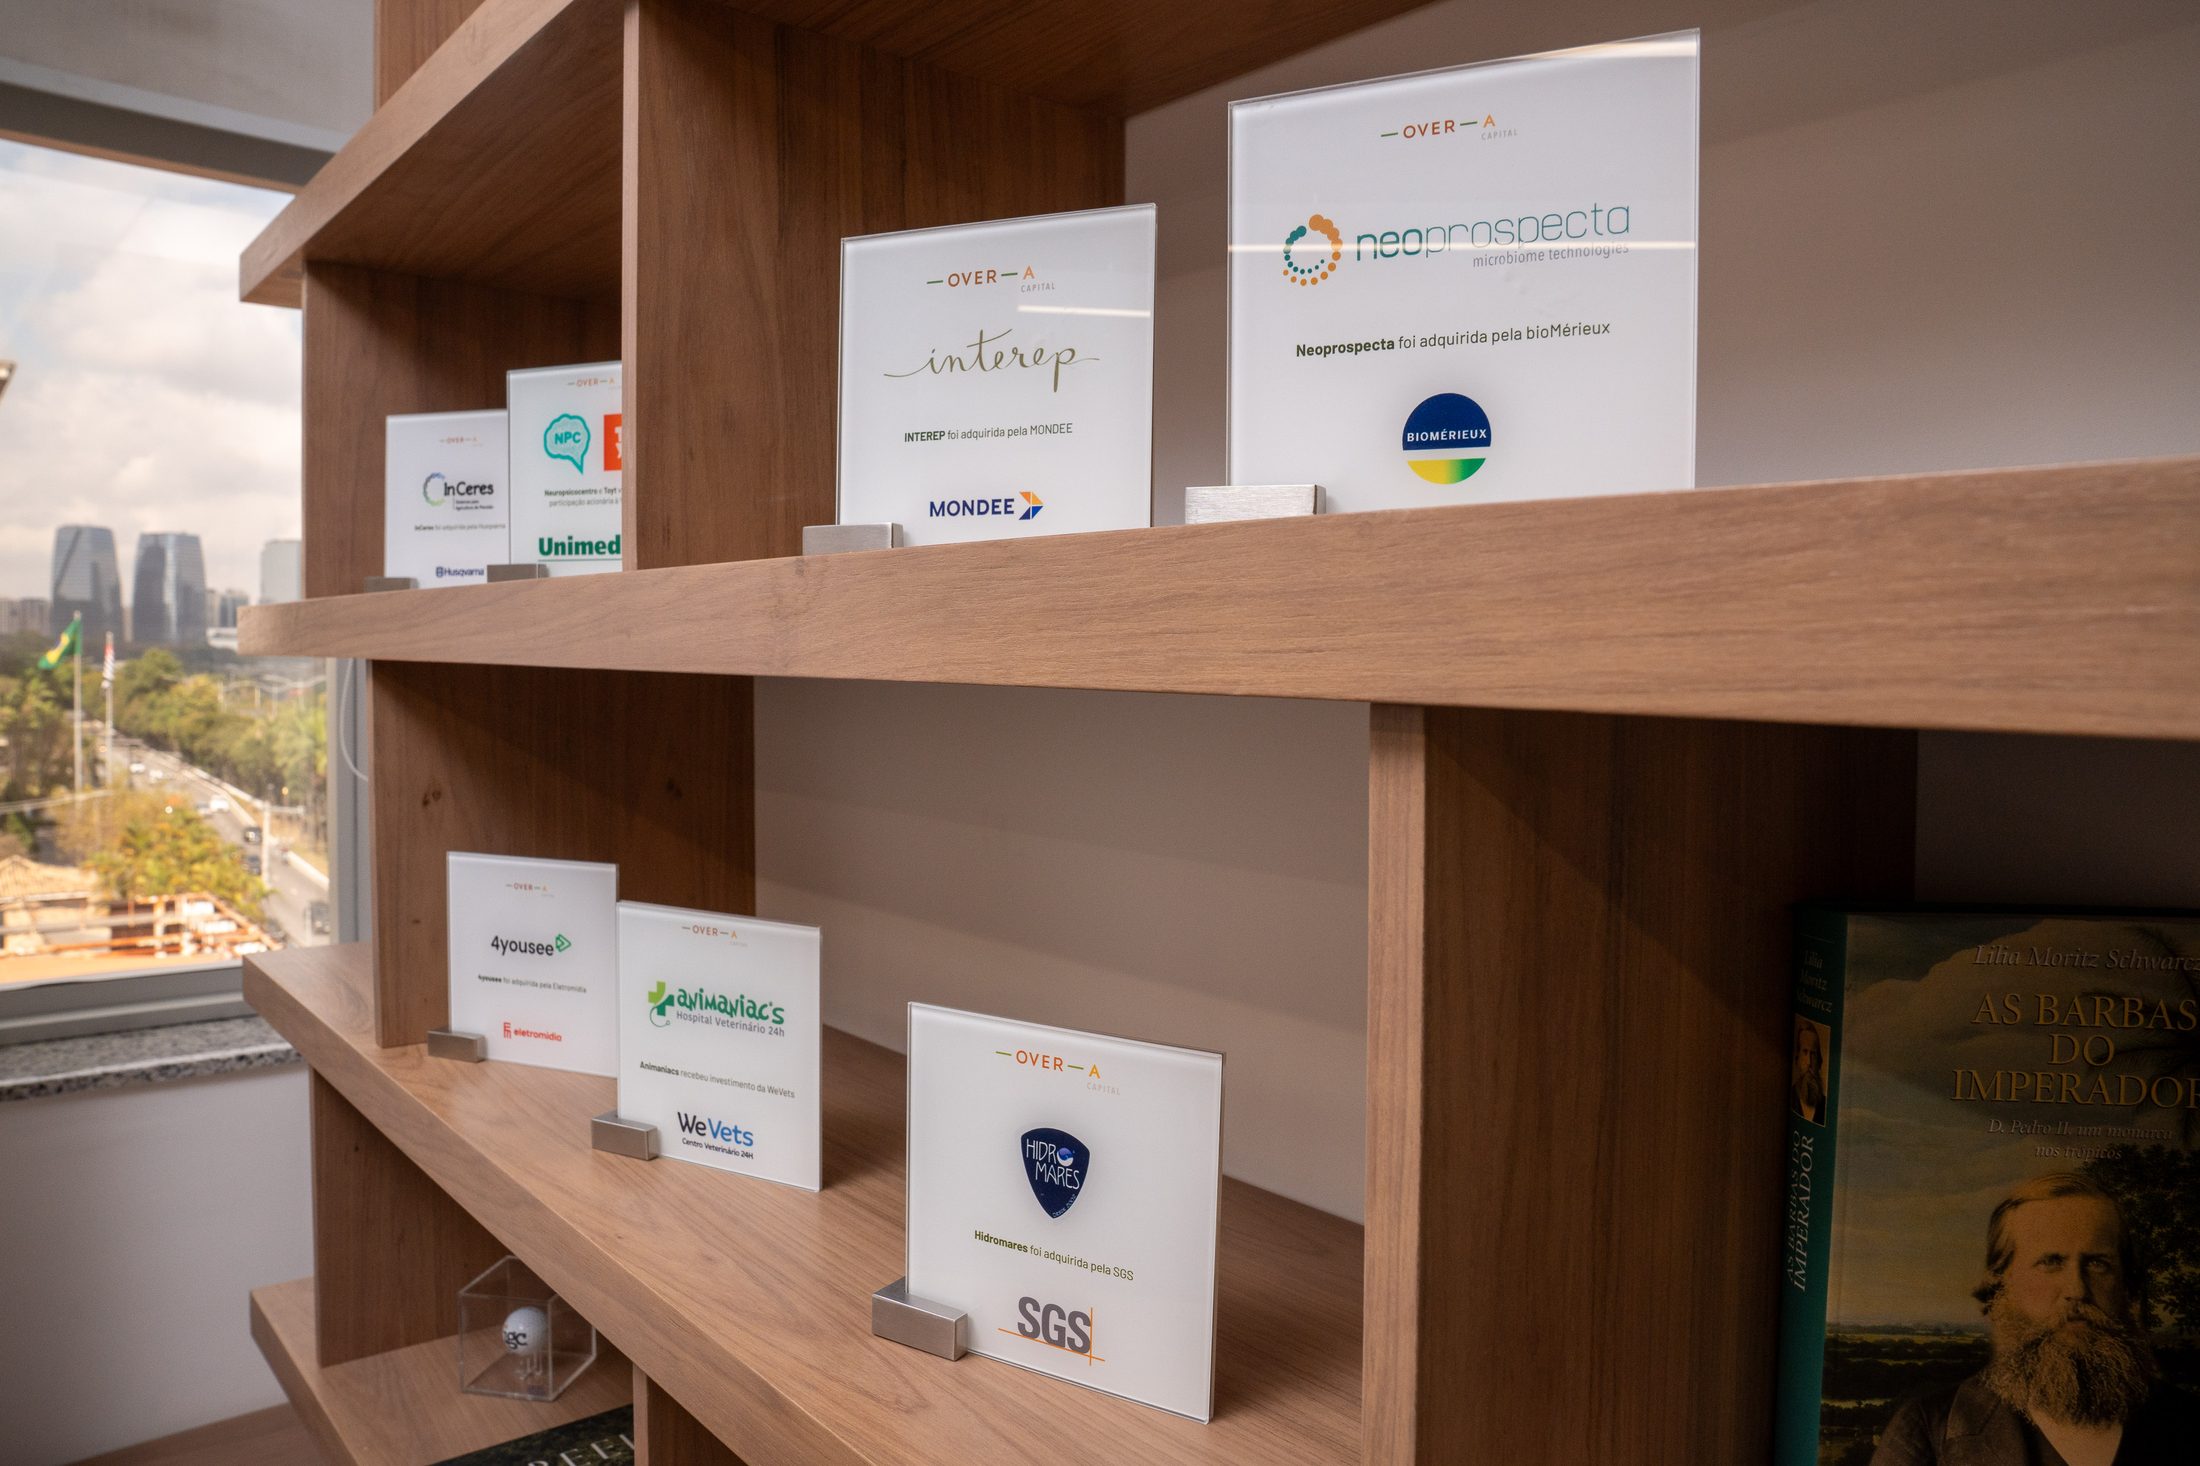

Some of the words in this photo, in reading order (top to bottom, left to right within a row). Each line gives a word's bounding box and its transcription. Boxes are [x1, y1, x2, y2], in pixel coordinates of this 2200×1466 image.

[1403, 119, 1456, 139] OVER
[1483, 113, 1496, 128] A
[1480, 129, 1518, 141] CAPITAL
[1356, 202, 1630, 262] neoprospecta
[1472, 248, 1545, 268] microbiome
[1548, 241, 1630, 261] technologies
[947, 269, 998, 288] OVER
[1020, 282, 1056, 293] CAPITAL
[1296, 337, 1396, 358] Neoprospecta
[1398, 334, 1416, 350] foi
[1419, 330, 1488, 349] adquirida
[1491, 326, 1523, 345] pela
[1526, 322, 1611, 340] bioMérieux
[883, 328, 1100, 393] interep
[576, 378, 599, 388] OVER
[554, 431, 582, 445] NPC
[904, 430, 946, 443] INTEREP
[947, 430, 960, 440] foi
[960, 427, 1006, 441] adquirida
[1007, 425, 1029, 439] pela
[1030, 422, 1074, 436] MONDEE
[1406, 427, 1488, 443] BIOMÉRIEUX
[444, 481, 495, 497] InCeres
[929, 497, 1015, 518] MONDEE
[538, 534, 621, 556] Unimed
[513, 882, 533, 891] OVER
[692, 925, 719, 936] OVER
[491, 935, 554, 956] 4yousee
[1973, 944, 2019, 966] Lilia
[2025, 947, 2099, 969] Moritz
[1972, 993, 2021, 1025] AS
[2033, 993, 2198, 1031] BARBAS
[676, 1010, 713, 1025] Hospital
[714, 1017, 766, 1034] Veterinário
[768, 1026, 785, 1037] 24h
[1016, 1050, 1064, 1072] OVER
[2048, 1033, 2115, 1067] DO
[640, 1061, 680, 1076] Animaniacs
[680, 1069, 709, 1082] recebeu
[710, 1074, 756, 1091] investimento
[757, 1084, 766, 1093] da
[767, 1085, 796, 1098] WeVets
[2009, 1119, 2050, 1136] Pedro
[682, 1138, 703, 1149] Centro
[705, 1142, 740, 1157] Veterinário
[1035, 1161, 1080, 1190] MARES
[1794, 1135, 1815, 1292] IMPERADOR
[974, 1230, 1028, 1253] Hidromares
[1030, 1245, 1042, 1257] foi
[1043, 1250, 1089, 1269] adquirida
[1090, 1262, 1111, 1275] pela
[1112, 1266, 1134, 1281] SGS
[1017, 1296, 1092, 1354] SGS
